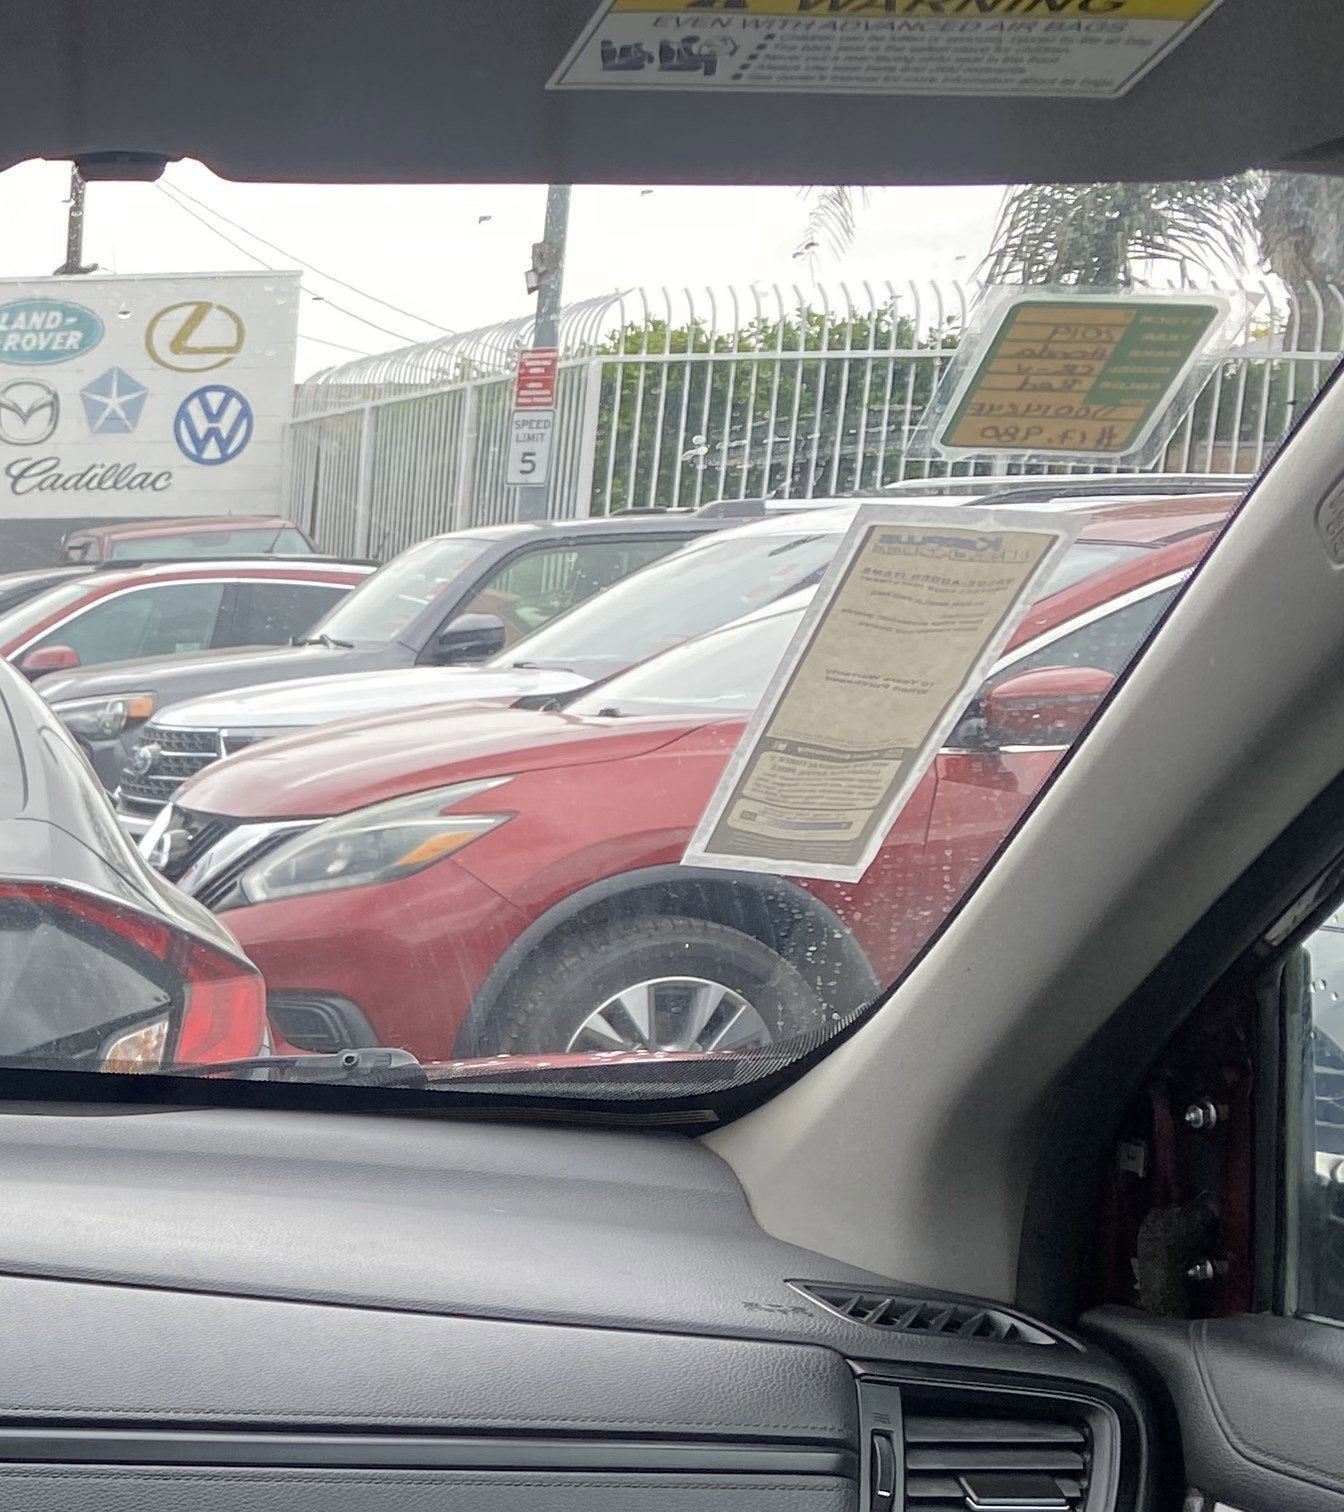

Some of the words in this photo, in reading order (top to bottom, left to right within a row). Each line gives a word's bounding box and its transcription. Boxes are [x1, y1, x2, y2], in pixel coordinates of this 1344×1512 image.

[514, 418, 552, 431] SPEED
[515, 432, 546, 443] LIMIT
[519, 451, 536, 475] 5
[5, 456, 174, 497] Cadillac
